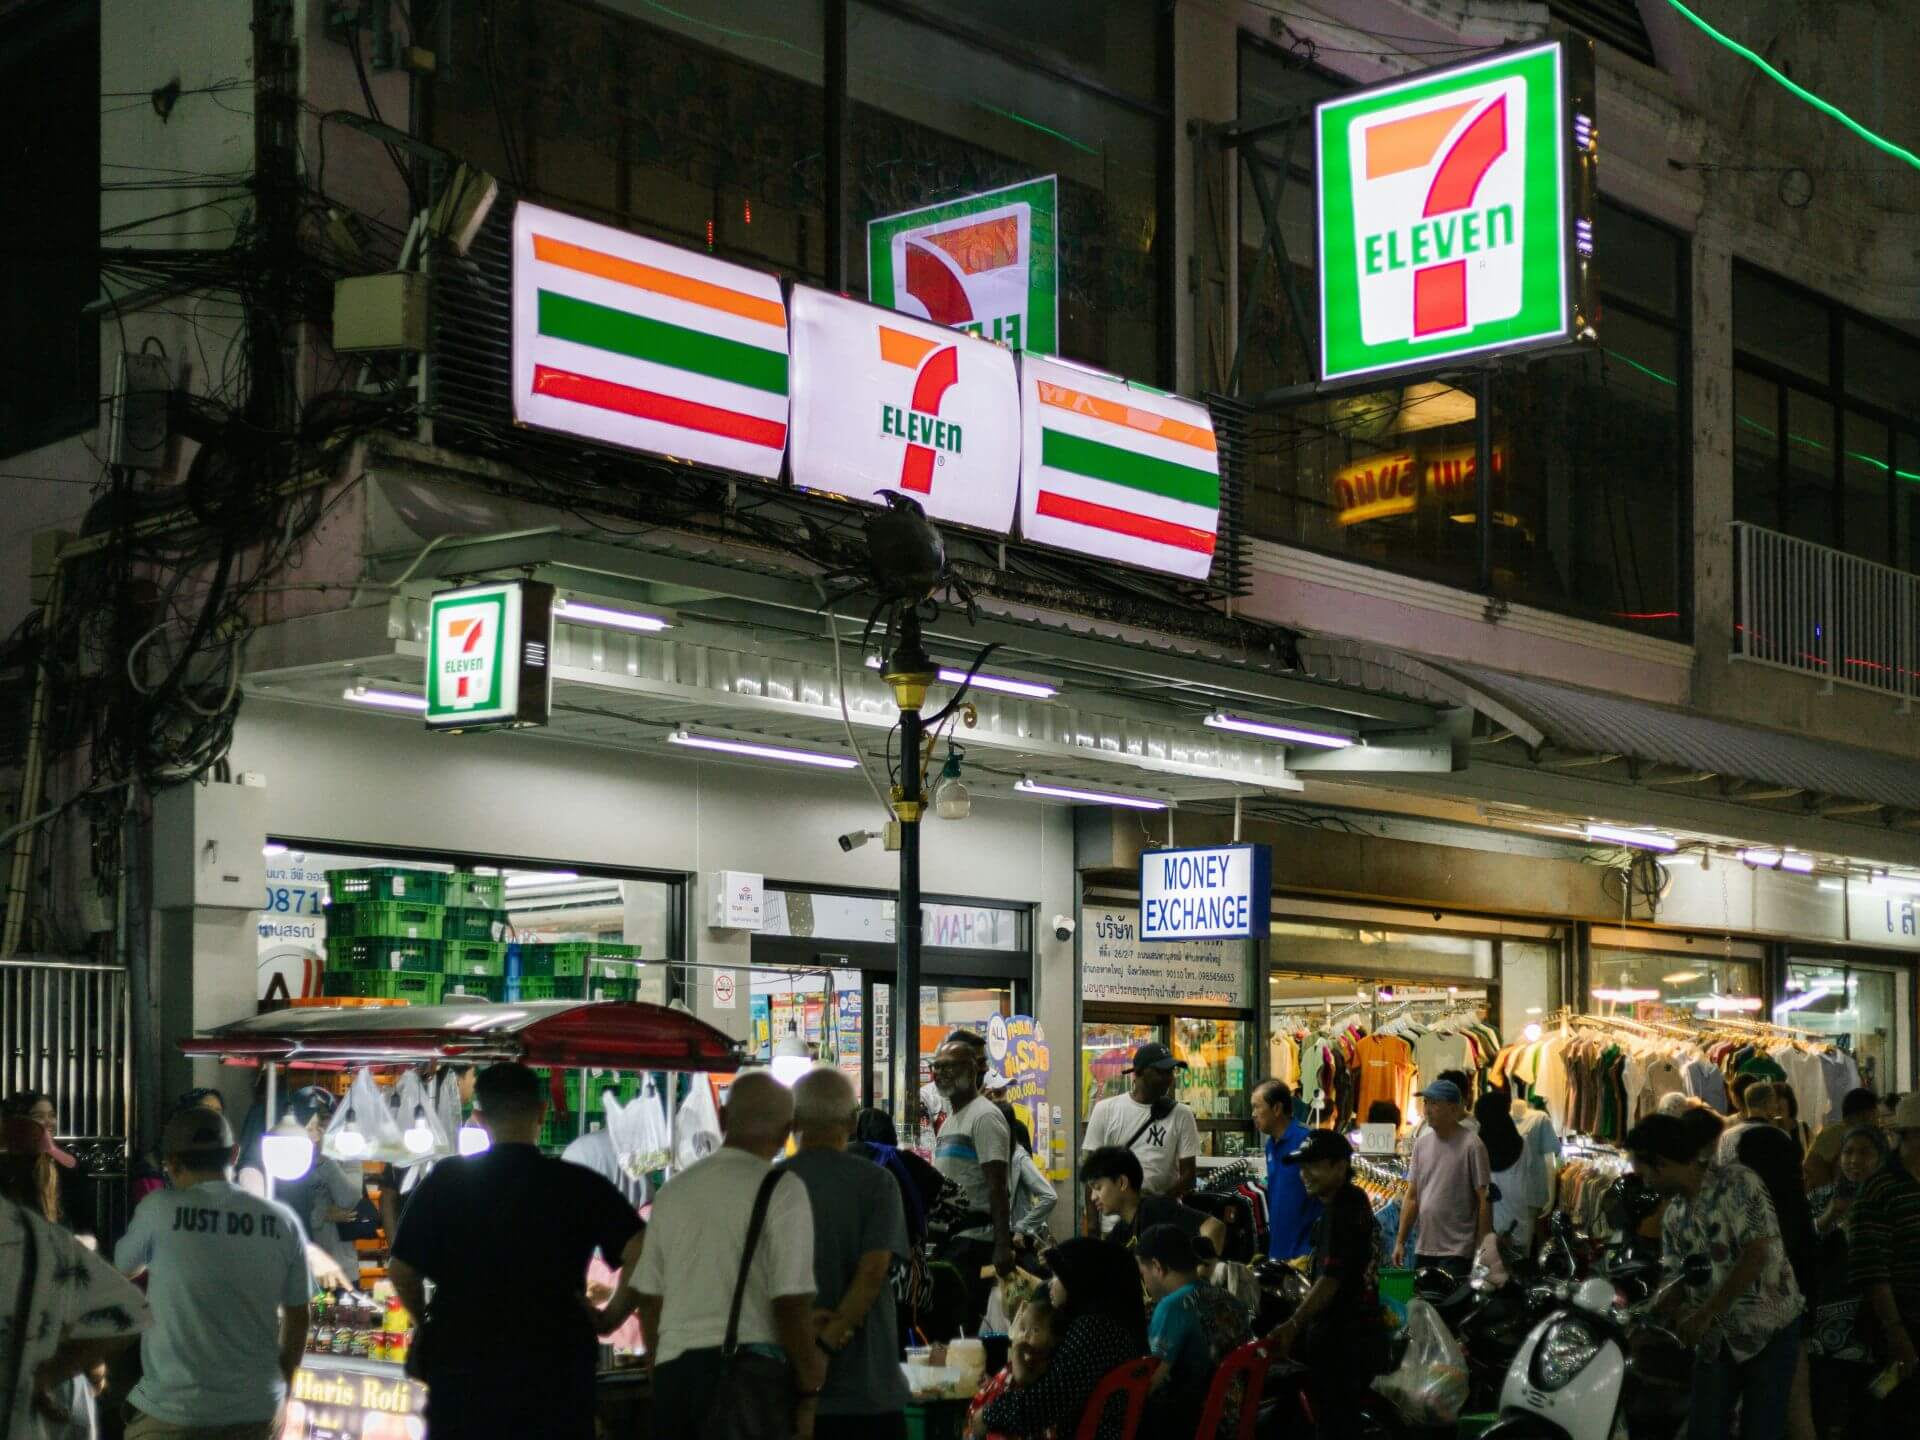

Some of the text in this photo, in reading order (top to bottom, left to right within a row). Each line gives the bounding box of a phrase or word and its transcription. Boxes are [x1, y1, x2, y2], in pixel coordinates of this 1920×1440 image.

[1365, 91, 1508, 338] 7
[879, 325, 958, 495] 7
[447, 617, 484, 698] 7
[1163, 855, 1231, 890] MONEY
[1095, 914, 1134, 941] บริษัท
[1146, 895, 1248, 932] EXCHANGE
[1146, 1125, 1167, 1148] NY
[173, 1206, 281, 1240] JUST DO IT.
[361, 1377, 409, 1413] Roti
